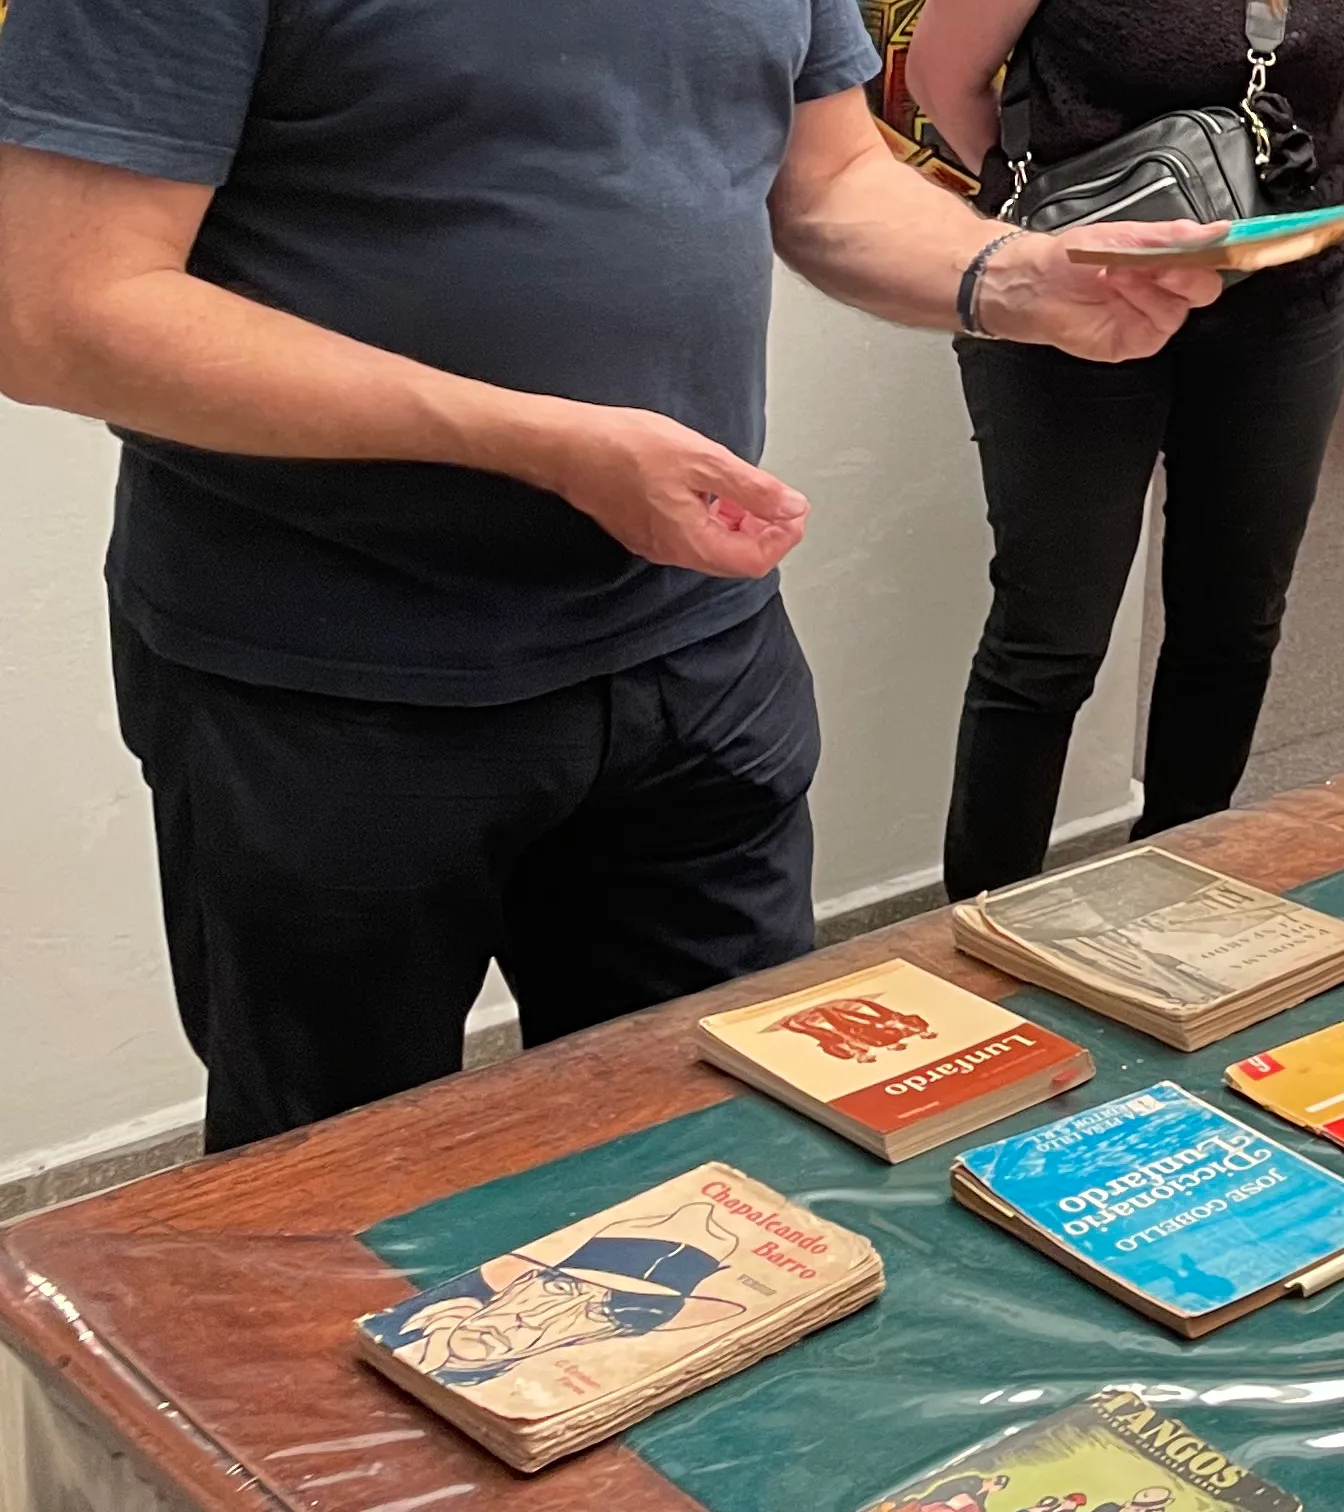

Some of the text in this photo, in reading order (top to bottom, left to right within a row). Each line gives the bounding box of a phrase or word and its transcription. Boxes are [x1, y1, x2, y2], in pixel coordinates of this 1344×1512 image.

[884, 1031, 1038, 1097] Lunfardo
[1058, 1134, 1253, 1216] Lunfardo
[1062, 1147, 1273, 1238] Diccionario
[1115, 1167, 1289, 1253] JOSE GOBELLO
[751, 1240, 817, 1280] Barro
[1102, 1391, 1249, 1488] TANGOS
